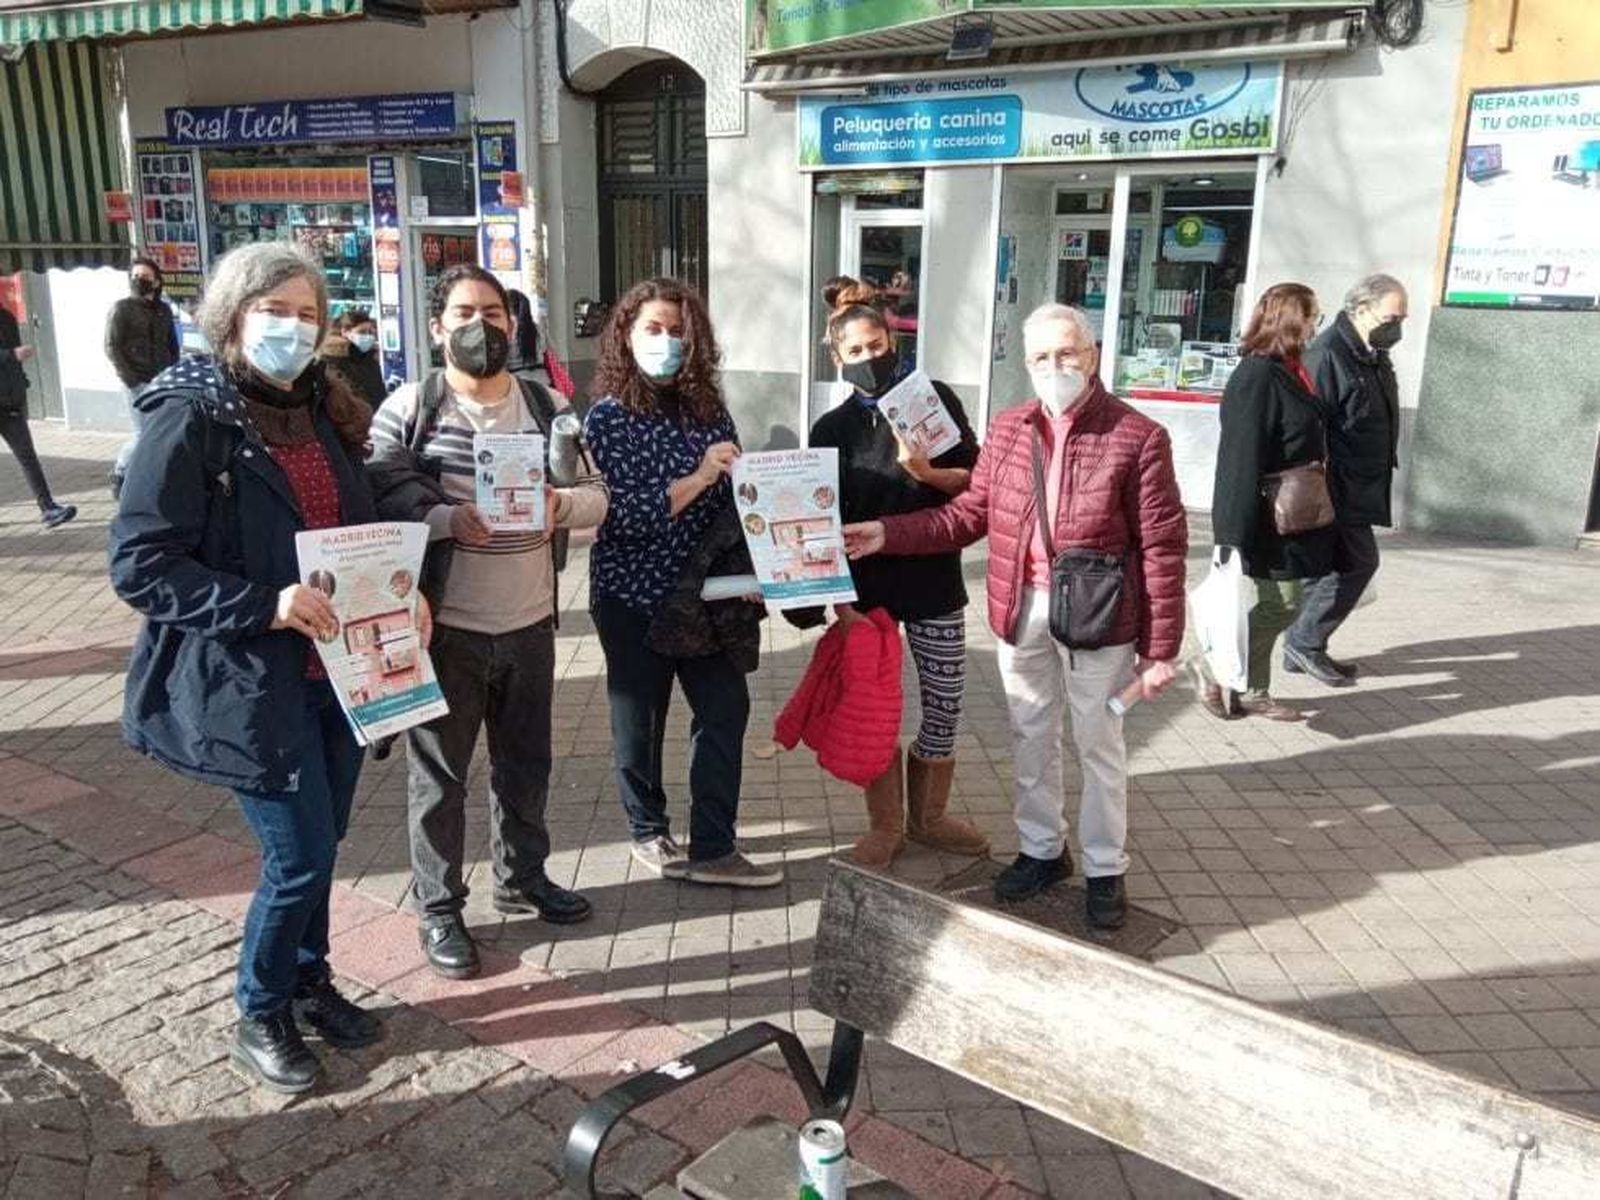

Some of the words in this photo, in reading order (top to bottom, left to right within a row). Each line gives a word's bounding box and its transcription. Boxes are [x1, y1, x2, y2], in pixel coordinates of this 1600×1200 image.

[884, 78, 910, 97] tipo
[915, 78, 932, 94] de
[938, 74, 1007, 92] mascotas
[1109, 92, 1208, 118] MASCOTAS
[1473, 92, 1581, 111] REPARAMOS
[174, 106, 232, 144] Real
[235, 102, 298, 139] Tech
[939, 108, 1007, 129] canina
[1099, 130, 1121, 144] se
[1129, 128, 1181, 144] come
[1189, 114, 1271, 141] Gosbi
[1480, 116, 1501, 130] TU
[833, 134, 915, 153] alimentación
[920, 138, 928, 152] y
[933, 132, 1006, 149] accesorios
